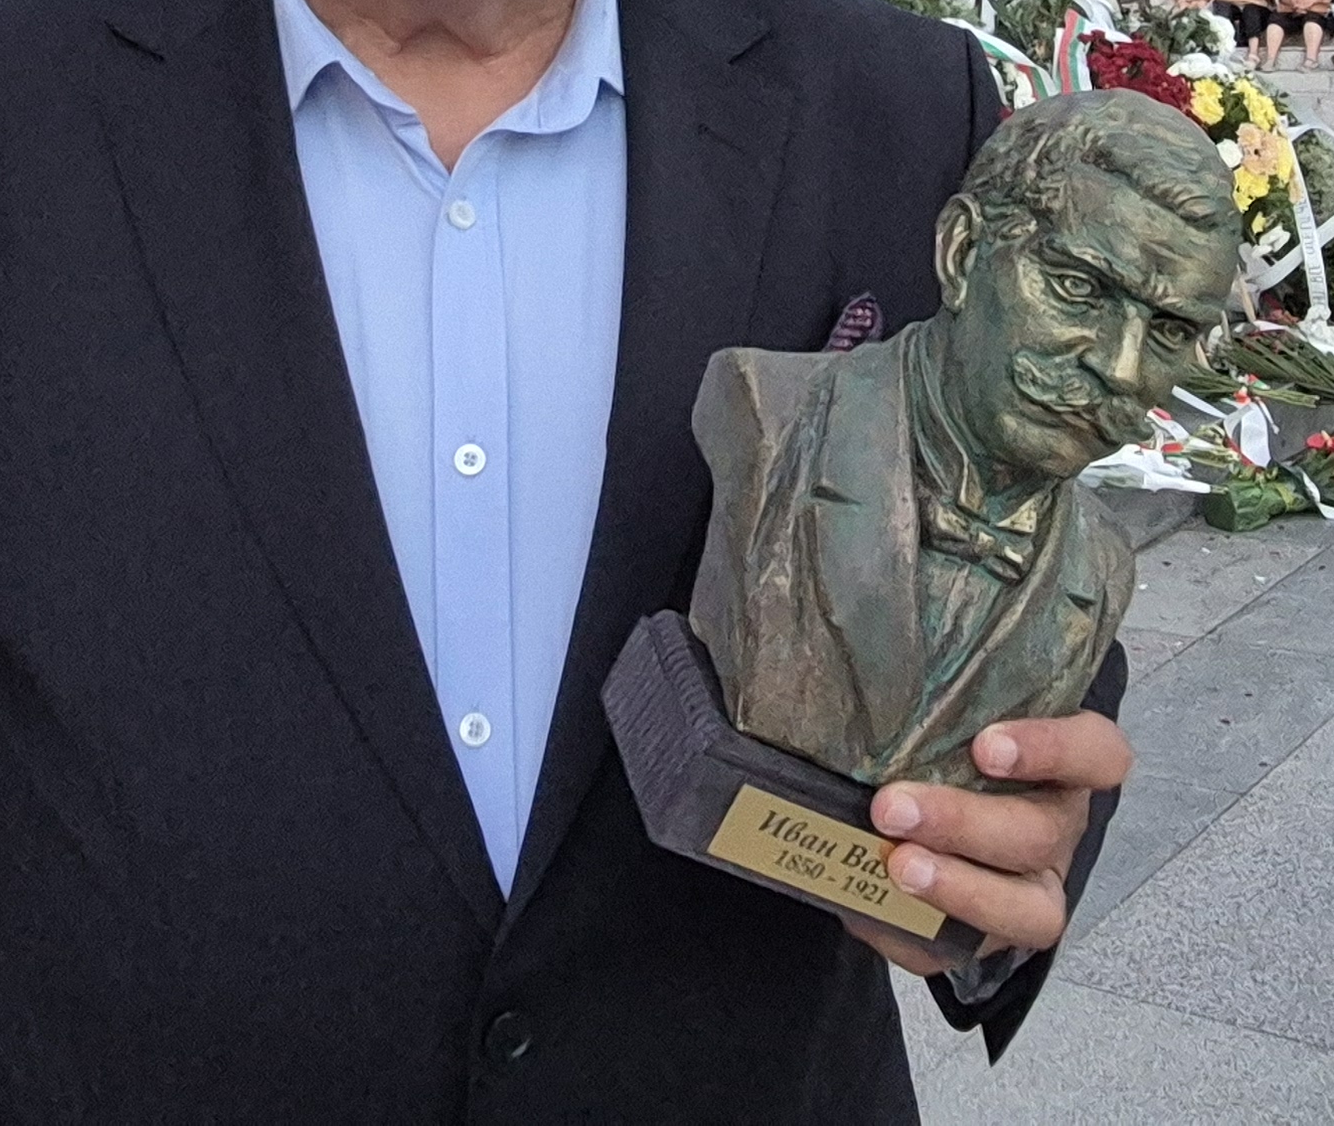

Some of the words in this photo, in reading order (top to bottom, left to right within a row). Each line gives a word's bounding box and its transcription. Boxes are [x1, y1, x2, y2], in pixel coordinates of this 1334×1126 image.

[758, 809, 837, 858] Иван
[774, 850, 826, 880] 1850
[842, 875, 890, 906] 1921
